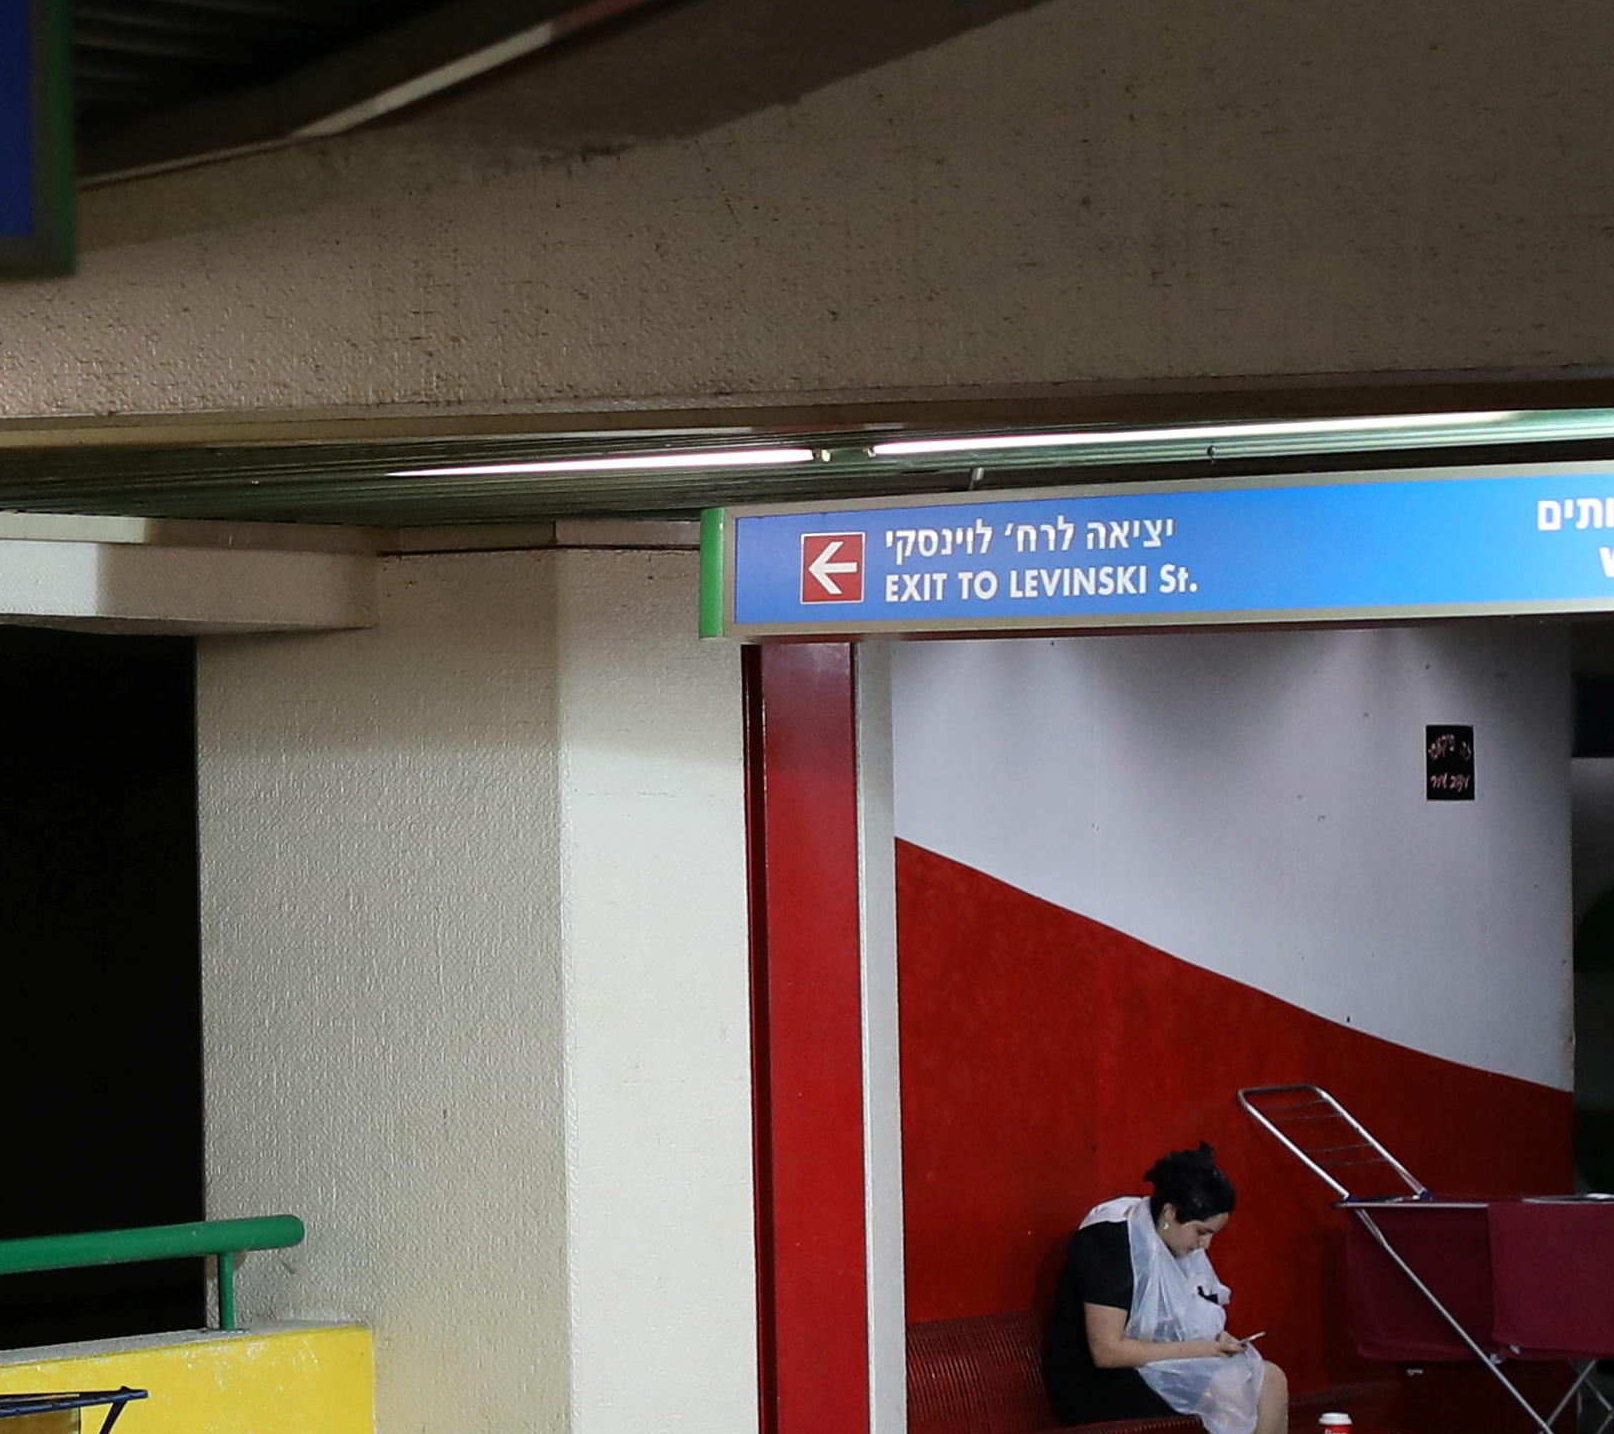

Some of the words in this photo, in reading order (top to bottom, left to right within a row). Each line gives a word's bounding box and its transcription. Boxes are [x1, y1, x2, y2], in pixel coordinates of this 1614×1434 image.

[885, 518, 993, 566] לוינסקי
[1086, 519, 1173, 551] יציאה
[885, 571, 948, 603] EXIT
[957, 570, 998, 601] TO
[1010, 565, 1147, 598] LEVINSKI
[1159, 563, 1199, 594] St.
